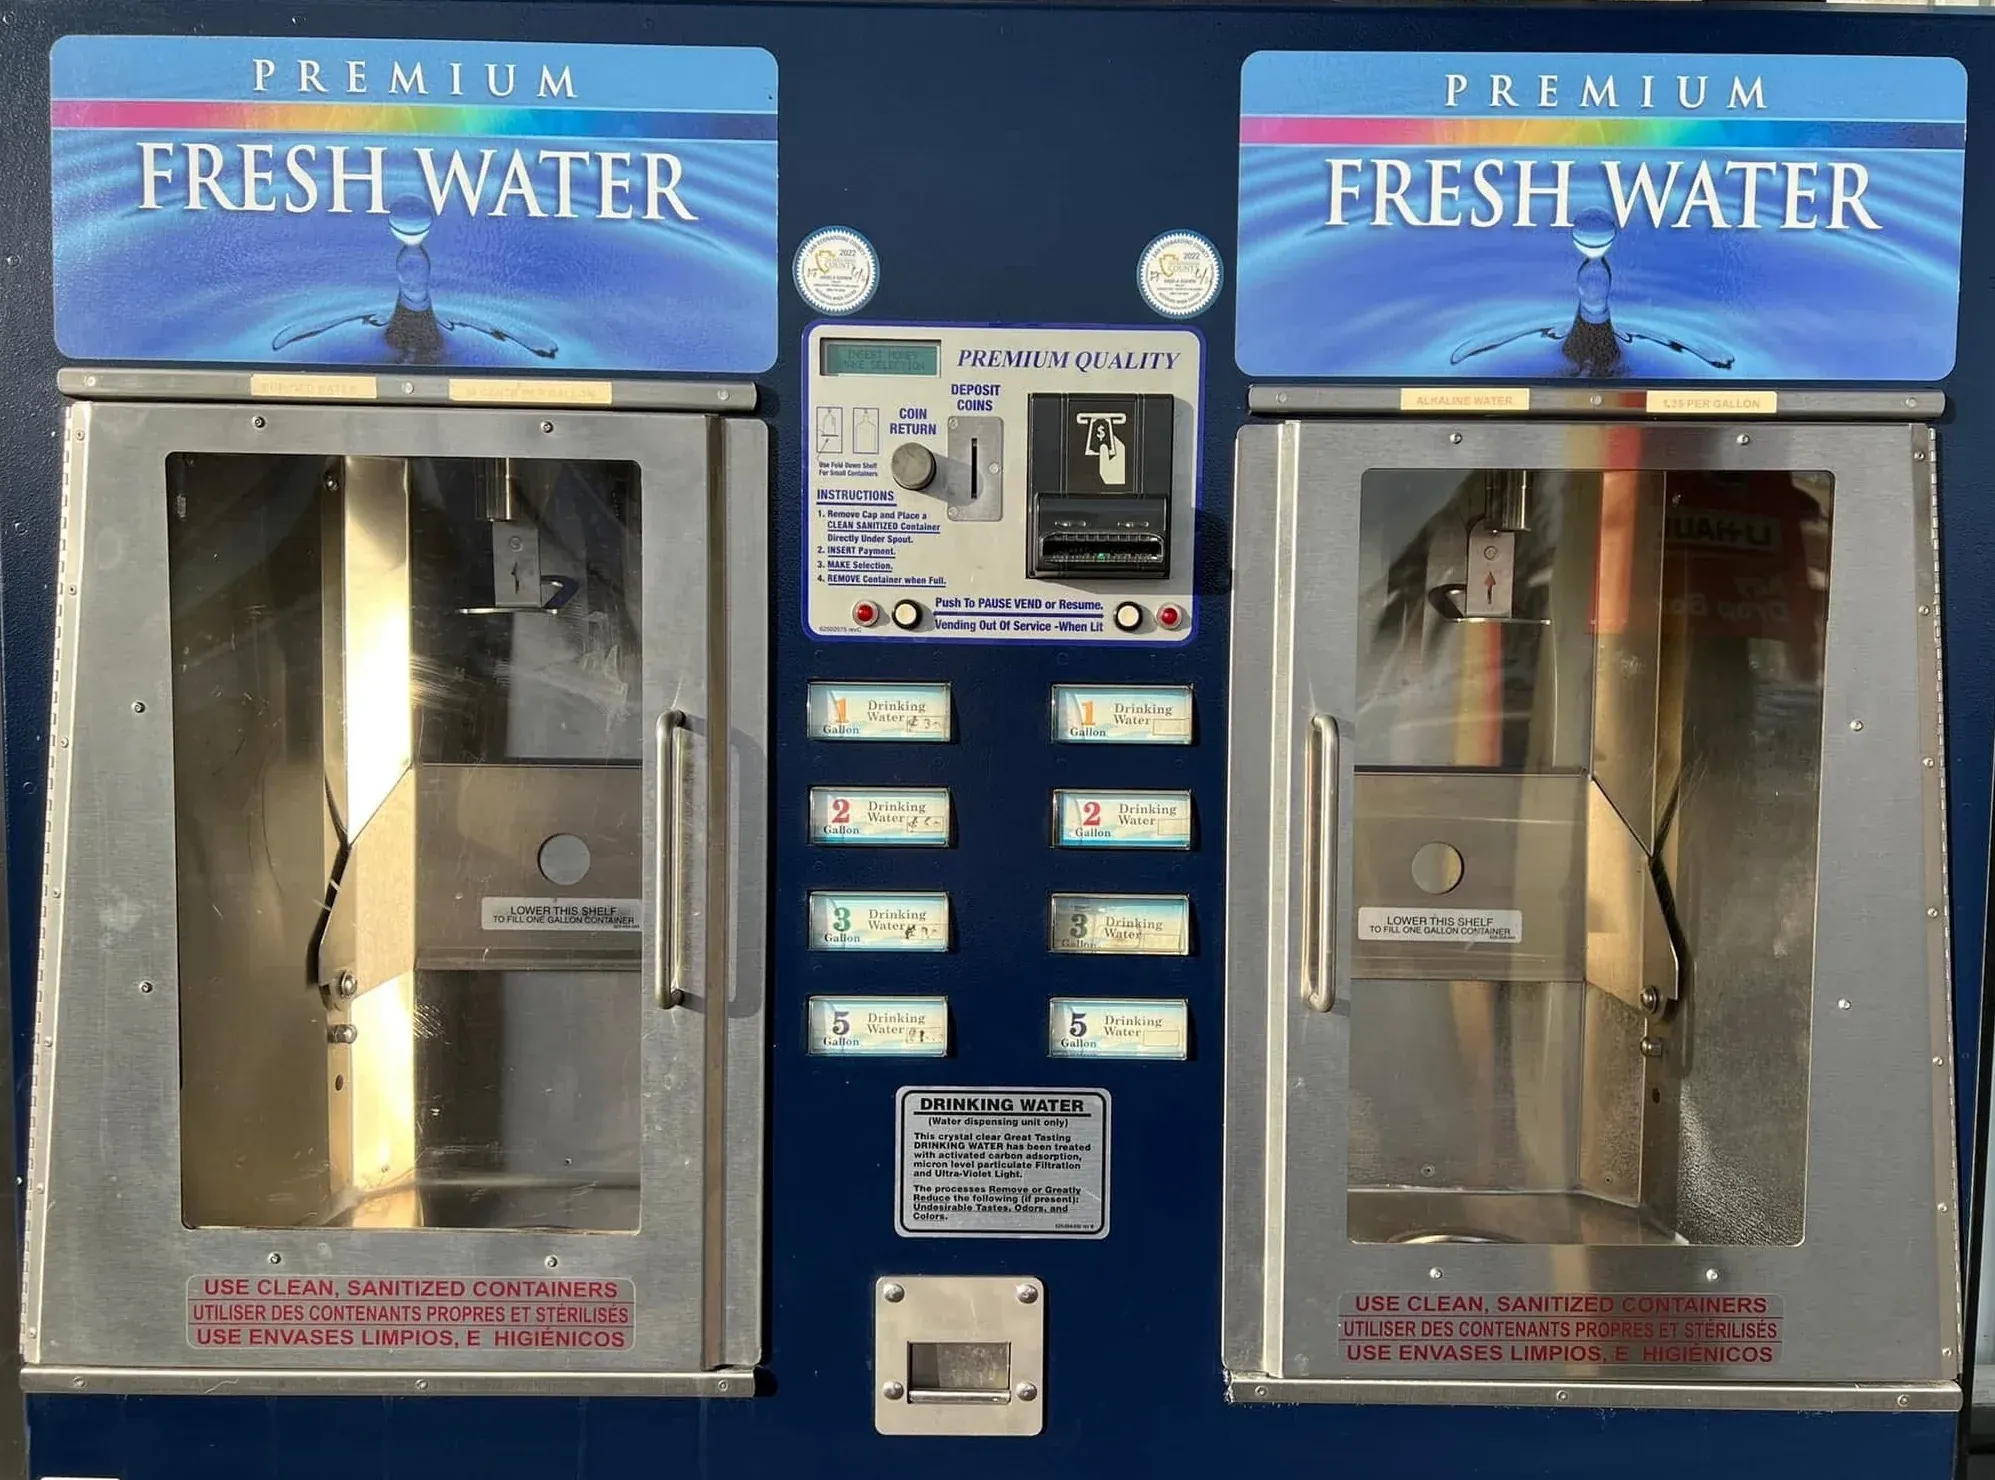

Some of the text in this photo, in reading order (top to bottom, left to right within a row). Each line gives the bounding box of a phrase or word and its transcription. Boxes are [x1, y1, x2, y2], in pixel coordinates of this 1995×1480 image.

[252, 58, 578, 99] PREMIUM
[1445, 73, 1768, 109] PREMIUM
[136, 141, 699, 221] FRESH WATER
[1325, 158, 1882, 231] FRESH WATER
[957, 350, 1181, 370] PREMIUM QUALITY
[951, 384, 1001, 395] DEPOSIT
[957, 400, 993, 411] COINS
[1416, 395, 1513, 406] ALKALINE WATER
[1687, 399, 1710, 408] PER
[1713, 399, 1761, 409] GALLON
[900, 408, 927, 419] COIN
[890, 423, 936, 435] RETURN
[817, 490, 894, 500] INSTRUCTIONS
[828, 510, 859, 518] Remove
[862, 511, 877, 520] Cap
[880, 511, 895, 519] and
[828, 521, 940, 531] CLEAN SANITIZED Container
[828, 535, 913, 544] Directly Under Spout.
[858, 547, 896, 556] Payment.
[935, 597, 1103, 610] Push To PAUSE VEND or Resume.
[935, 619, 1103, 633] Vending Out Of Service -When Lit
[836, 696, 848, 723] 1
[868, 700, 926, 712] Drinking
[1114, 704, 1172, 715] Drinking
[868, 712, 905, 722] Water
[1081, 701, 1096, 726] 1
[1114, 715, 1151, 725] Water
[823, 724, 859, 734] Gallon
[1070, 727, 1106, 736] Gallon
[832, 799, 850, 823] 2
[868, 801, 926, 813] Drinking
[868, 812, 905, 823] Water
[824, 825, 859, 834] Gallon
[511, 906, 617, 915] LOWER THIS SHELF
[869, 909, 927, 920] Drinking
[585, 916, 634, 924] CONTAINER
[833, 907, 850, 931] 3
[1387, 916, 1493, 926] LOWER THIS SHELF
[868, 920, 905, 930] Water
[824, 933, 860, 942] Gallon
[921, 1098, 1084, 1111] DRINKING WATER
[929, 1118, 961, 1126] (Water
[964, 1118, 1018, 1127] dispensing
[1044, 1119, 1068, 1127] only)
[938, 1133, 972, 1142] crystal
[1035, 1134, 1071, 1143] Tasting
[914, 1151, 935, 1159] with
[1026, 1153, 1082, 1162] adsorption,
[978, 1162, 1032, 1170] particulate
[935, 1170, 991, 1178] Ultra-Violet
[995, 1171, 1022, 1179] Light.
[935, 1186, 986, 1194] processes
[1045, 1186, 1081, 1195] Greatly
[973, 1195, 1018, 1204] following
[1021, 1196, 1031, 1204] (if
[1034, 1196, 1079, 1204] present):
[976, 1204, 1011, 1212] Tastes,
[1015, 1205, 1047, 1213] Odors,
[204, 1279, 618, 1298] USE CLEAN, SANITIZED CONTAINERS
[1355, 1296, 1767, 1314] USE CLEAN, SANITIZED CONTAINERS
[193, 1303, 629, 1323] UTILISER DES CONTENANTS PROPRES ET STÉRILISÉS
[197, 1327, 625, 1348] USE ENVASES LIMPIOS, E HIGIÉNICOS
